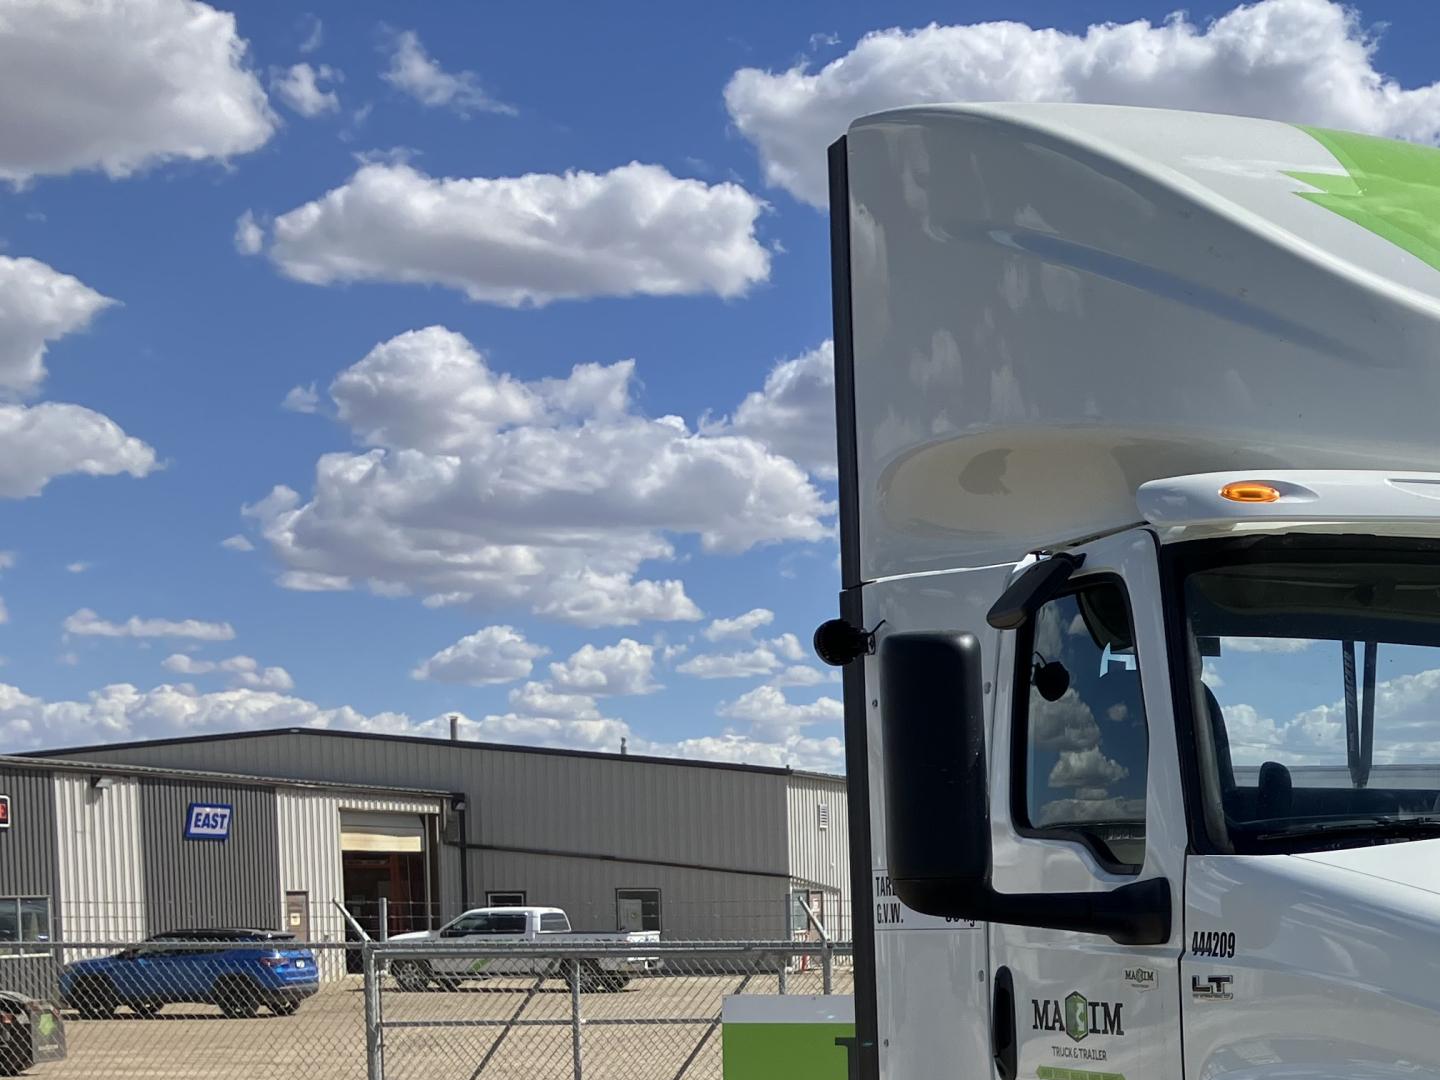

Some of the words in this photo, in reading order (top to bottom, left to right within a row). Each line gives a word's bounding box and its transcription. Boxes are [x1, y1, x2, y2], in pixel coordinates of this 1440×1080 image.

[193, 812, 228, 830] EAST
[875, 876, 896, 897] TAR
[1191, 930, 1236, 959] 444209
[1191, 974, 1234, 994] LT
[1051, 1046, 1074, 1058] TRUCK
[1079, 1047, 1107, 1061] TRAILER
